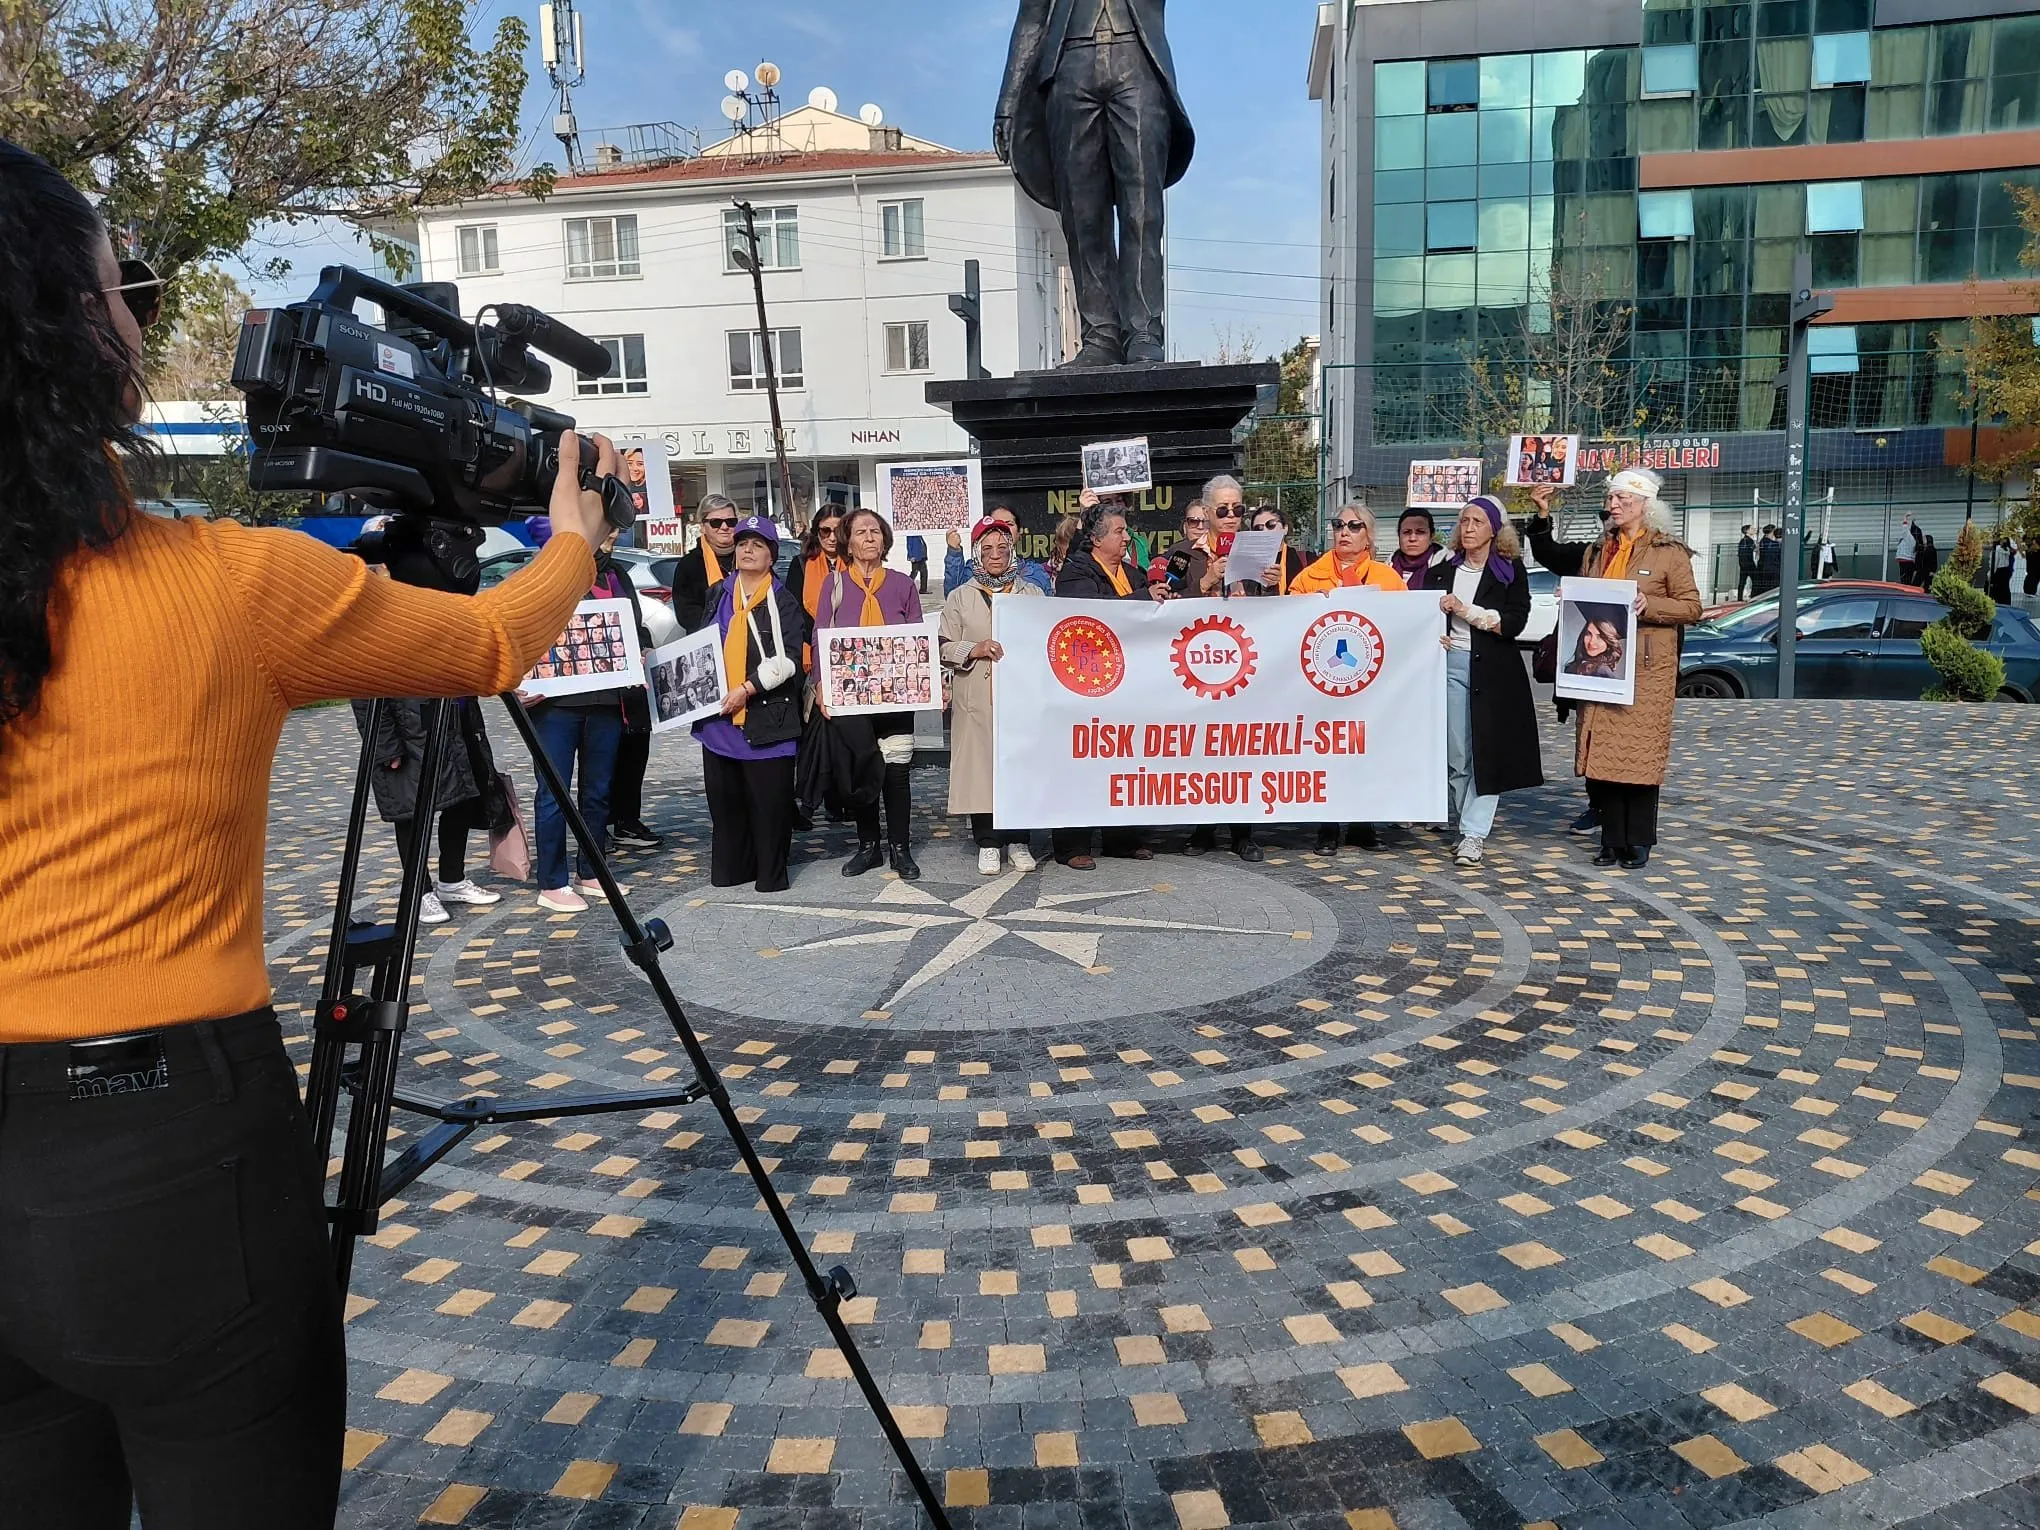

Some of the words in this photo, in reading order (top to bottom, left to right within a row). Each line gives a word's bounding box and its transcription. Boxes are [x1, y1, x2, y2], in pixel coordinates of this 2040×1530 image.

[339, 324, 370, 341] SONY
[356, 379, 387, 403] HD
[392, 397, 402, 407] Full
[403, 402, 413, 410] HD
[414, 404, 445, 420] 1920x1080
[260, 424, 291, 433] SONY
[1643, 438, 1710, 449] ANADOLU
[1189, 643, 1239, 665] DİSK
[1072, 717, 1136, 759] DİSK
[1143, 723, 1197, 758] DEV
[1204, 714, 1367, 757] EMEKLİ-SEN
[1109, 766, 1253, 807] ETİMESGUT
[1260, 770, 1327, 815] ŞUBE
[68, 1060, 168, 1100] mavi
